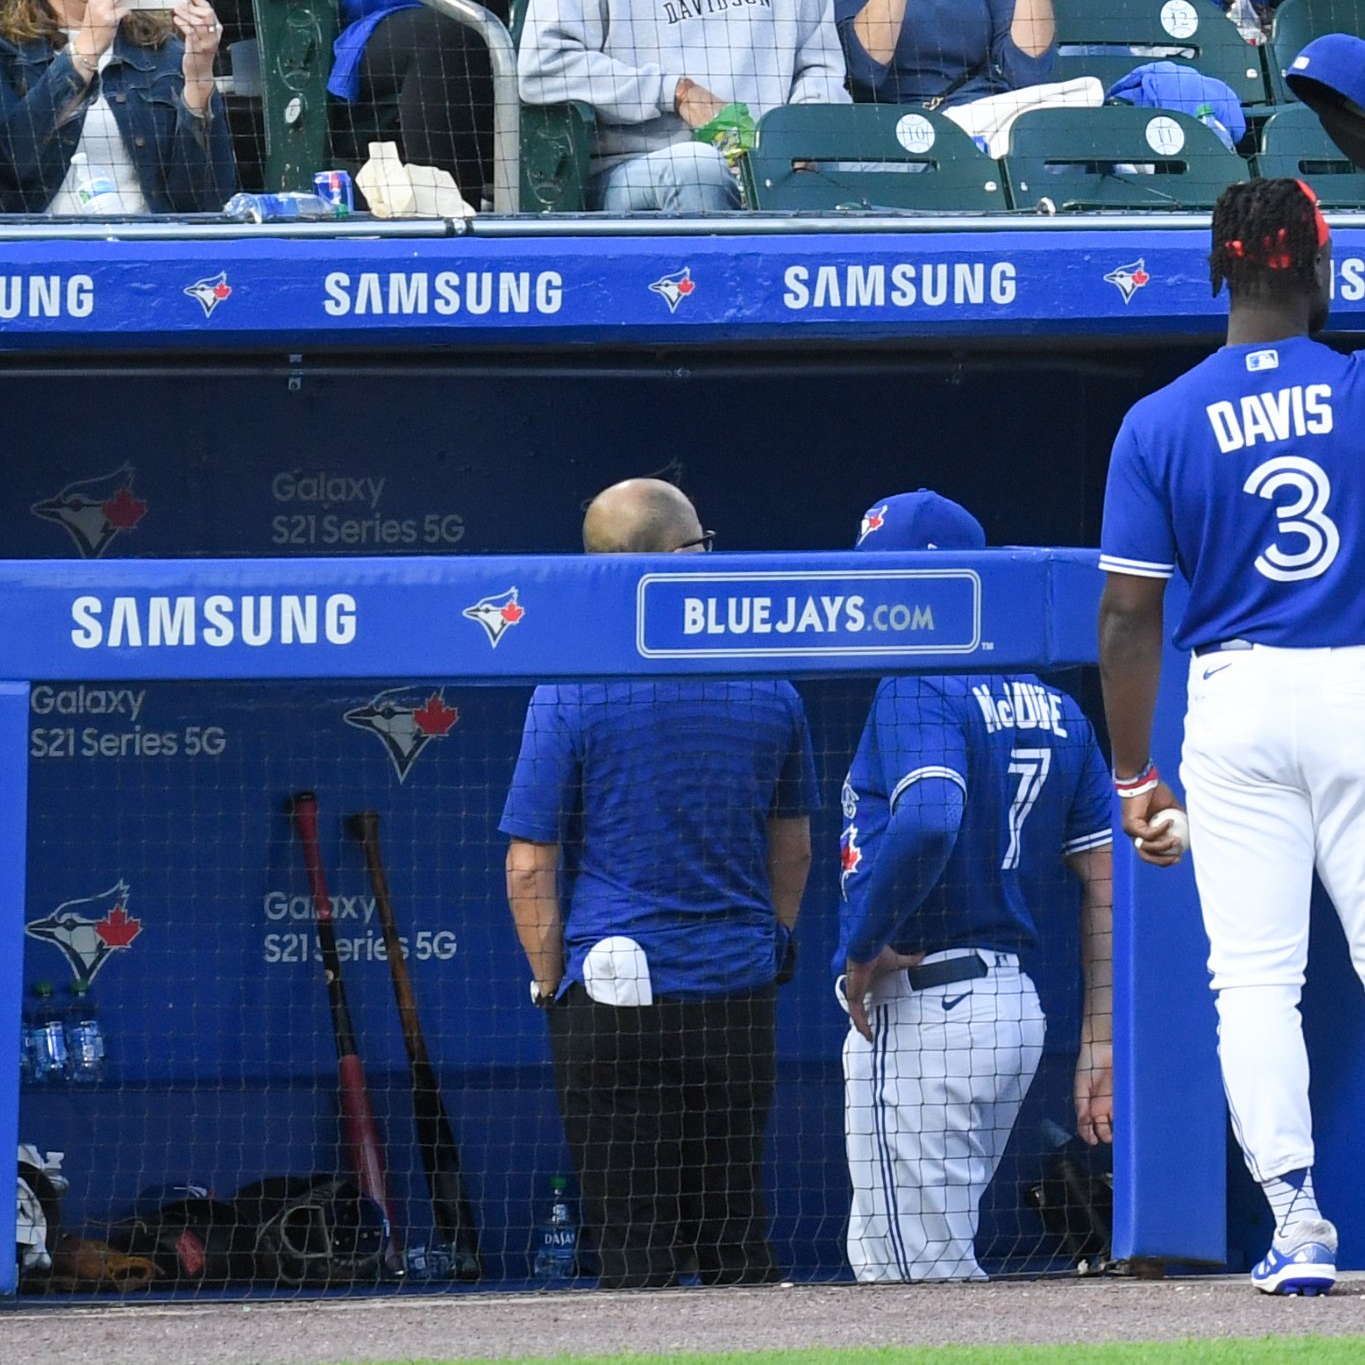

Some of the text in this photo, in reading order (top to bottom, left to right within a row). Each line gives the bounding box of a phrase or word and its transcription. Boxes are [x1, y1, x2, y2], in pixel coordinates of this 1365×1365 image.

[324, 270, 563, 316] SAMSUNG
[784, 262, 1017, 311] SAMSUNG
[1206, 383, 1333, 454] DAVIS
[272, 472, 386, 509] Galaxy
[272, 514, 466, 545] S21 Series 5G
[1242, 455, 1340, 582] 3
[70, 594, 358, 649] SAMSUNG
[30, 685, 146, 722] Galaxy
[30, 725, 227, 758] S21 Series 5G
[1002, 748, 1052, 871] 7
[264, 936, 313, 964] S21
[411, 932, 457, 961] 5G
